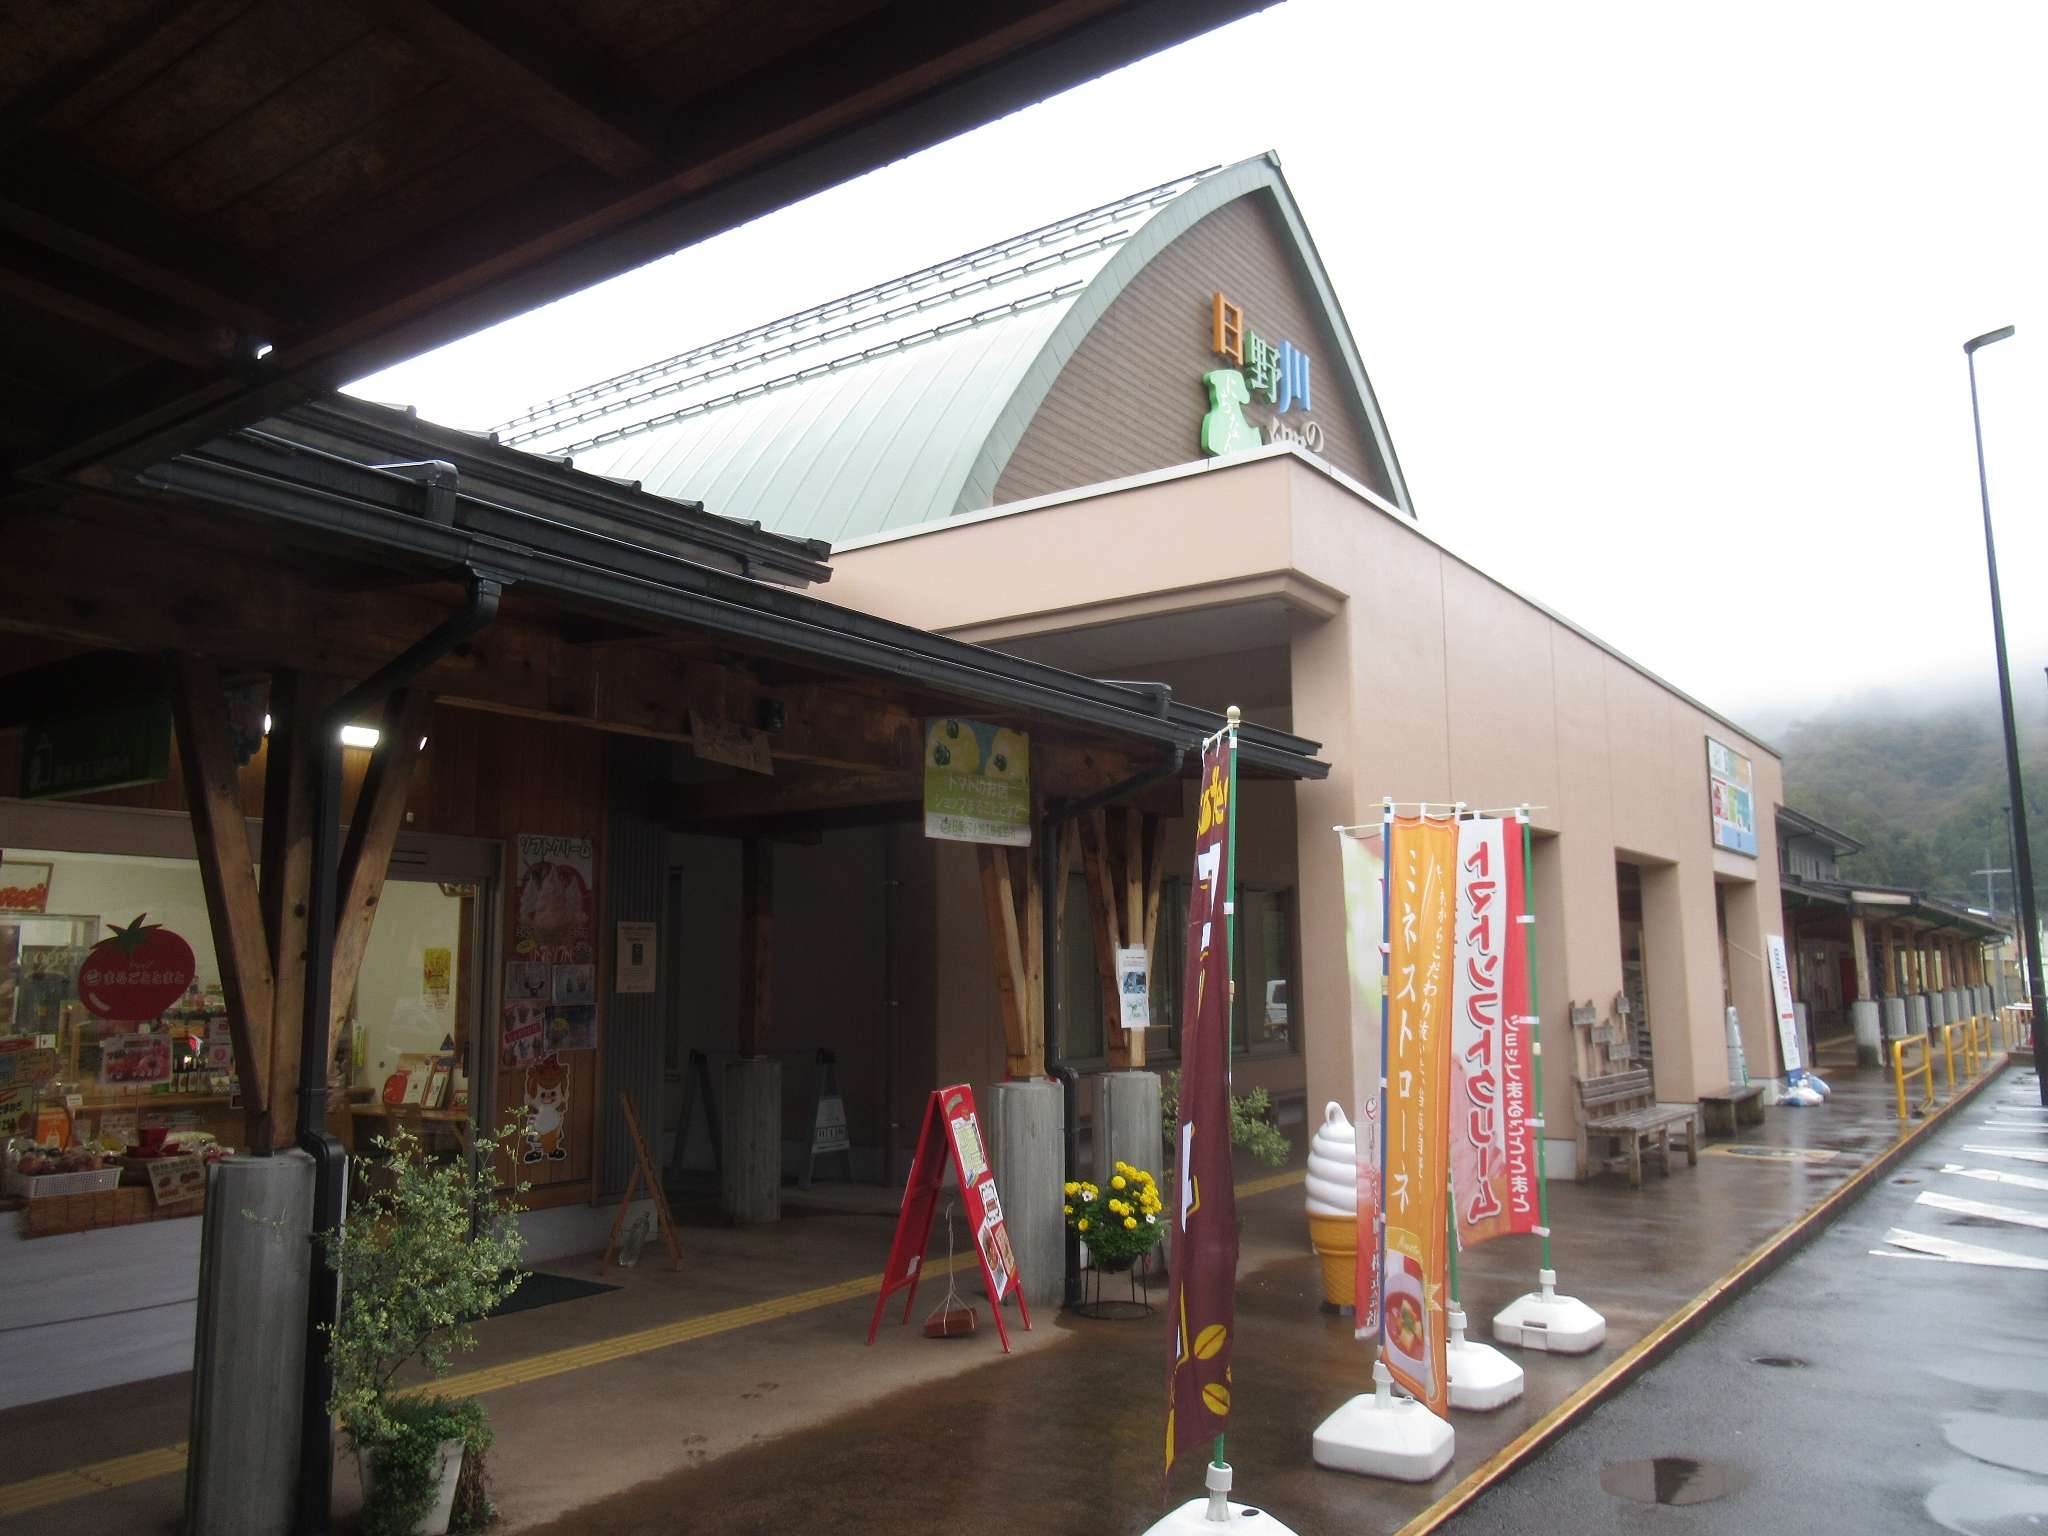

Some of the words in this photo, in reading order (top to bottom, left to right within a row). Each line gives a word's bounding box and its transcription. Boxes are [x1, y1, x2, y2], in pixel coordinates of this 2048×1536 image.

[1212, 291, 1311, 413] 日野川
[1391, 848, 1418, 1215] ミネストローネ
